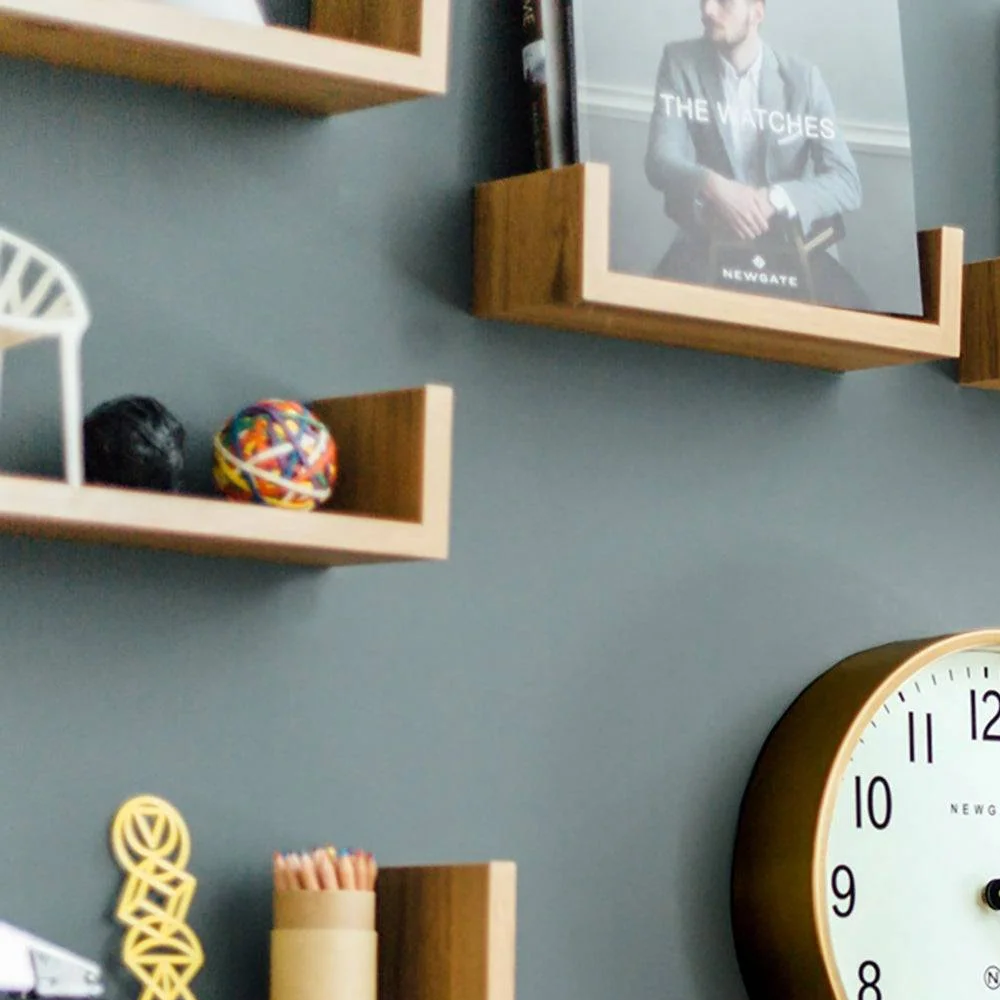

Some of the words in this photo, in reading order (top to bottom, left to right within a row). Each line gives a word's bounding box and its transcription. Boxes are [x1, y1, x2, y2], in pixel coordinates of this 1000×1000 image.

[659, 92, 710, 122] THE
[716, 101, 836, 140] WATCHES
[722, 267, 798, 288] NEWGATE
[855, 776, 892, 830] 10
[832, 865, 855, 918] 9
